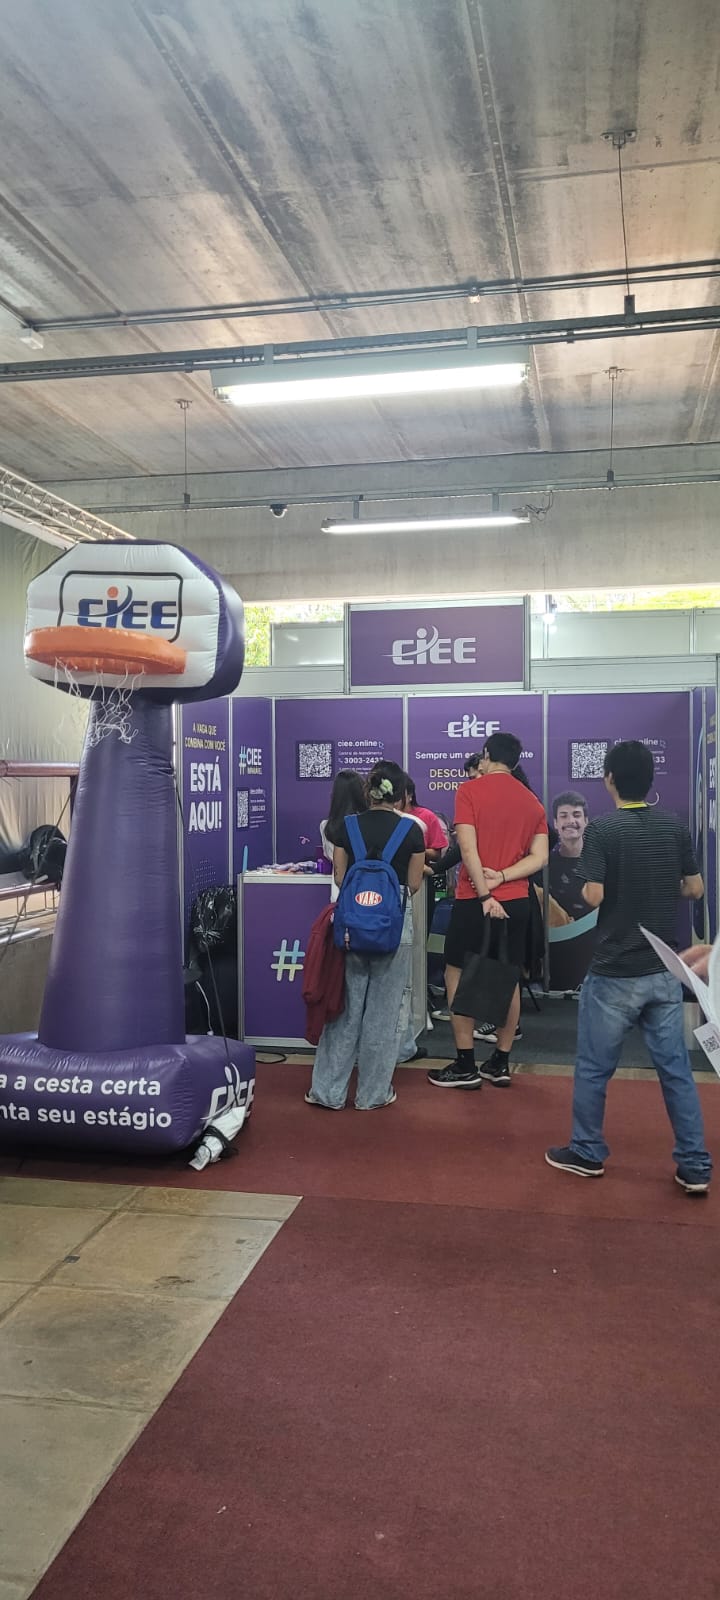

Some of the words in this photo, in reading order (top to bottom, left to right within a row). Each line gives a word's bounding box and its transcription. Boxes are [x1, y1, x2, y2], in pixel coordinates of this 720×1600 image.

[197, 723, 208, 734] VAGA
[208, 725, 217, 736] QUE
[415, 751, 448, 761] Sempre
[449, 752, 463, 760] um
[190, 755, 222, 792] ESTÁ
[429, 768, 470, 778] DESCU
[188, 801, 222, 832] AQUI!
[359, 891, 379, 906] VANS
[13, 1075, 27, 1091] a
[33, 1076, 93, 1094] cesta
[100, 1077, 161, 1096] certa
[37, 1107, 76, 1124] seu
[83, 1106, 172, 1130] estágio
